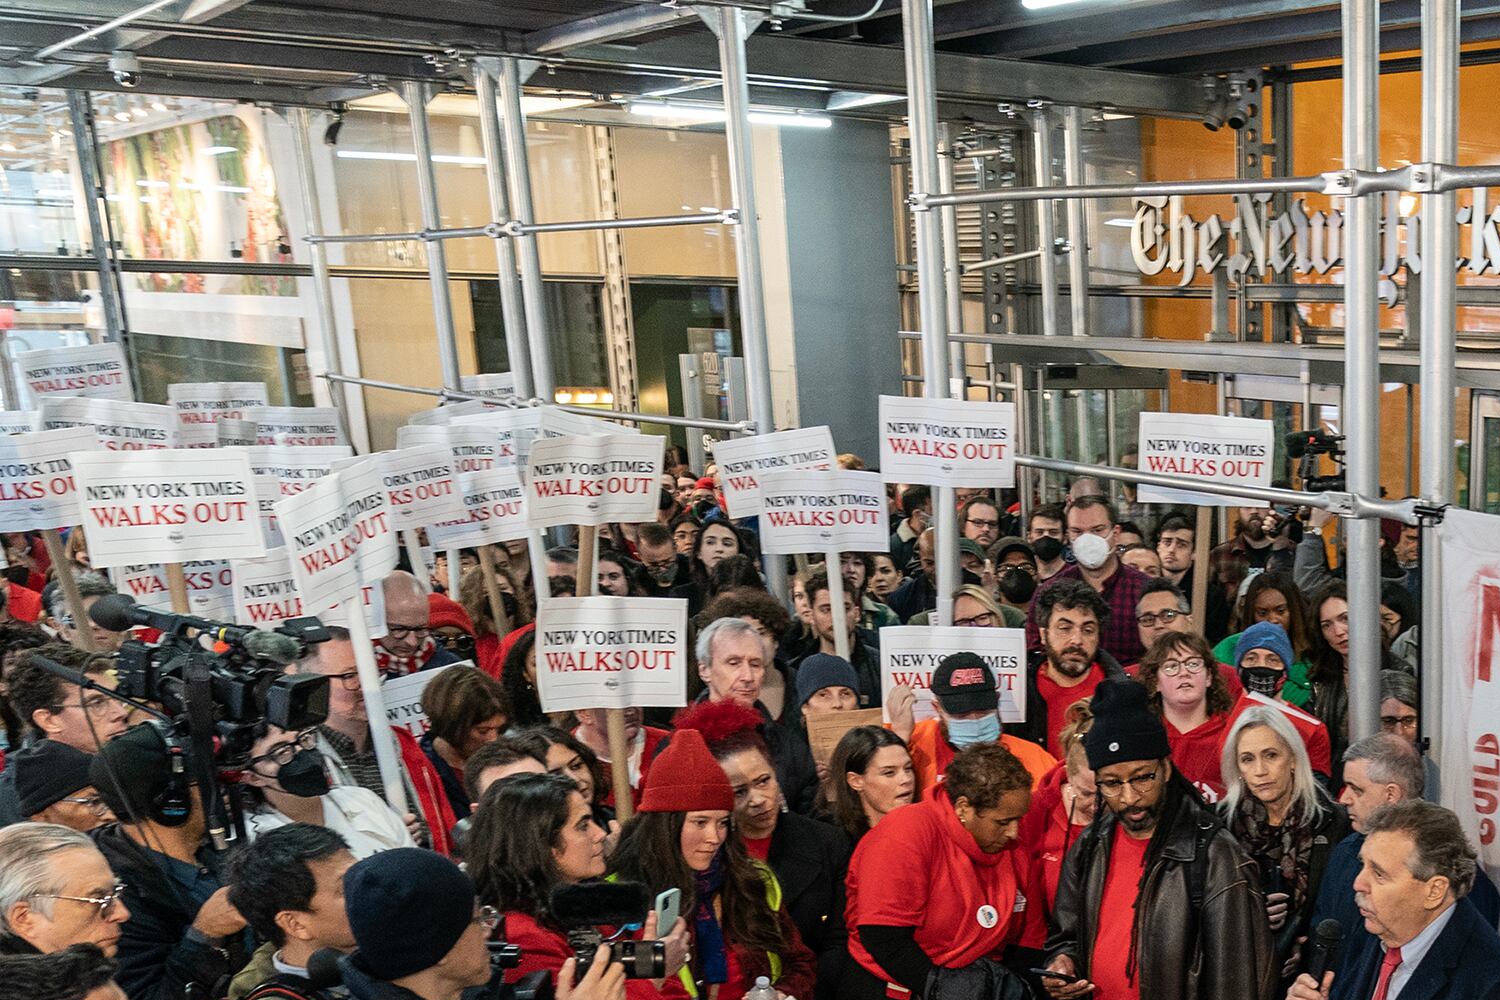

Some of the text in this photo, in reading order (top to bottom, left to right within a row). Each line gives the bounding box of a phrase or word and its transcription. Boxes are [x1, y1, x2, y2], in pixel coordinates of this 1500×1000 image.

[1130, 194, 1223, 287] The
[29, 372, 123, 393] WALKS OUT
[886, 422, 1007, 440] NEW YORK TIMES
[887, 438, 1008, 460] WALKS OUT
[1146, 440, 1266, 457] NEW YORK TIMES
[533, 460, 655, 477] NEW YORK TIMES
[723, 460, 754, 475] NEW
[755, 455, 789, 469] YORK
[790, 450, 828, 464] TIMES
[1147, 456, 1264, 478] WALKS OUT
[383, 465, 450, 488] ORK TIMES
[533, 476, 653, 498] WALKS OUT
[86, 484, 129, 501] NEW
[131, 482, 188, 499] YORK
[191, 481, 245, 497] TIMES
[416, 479, 453, 500] OUT
[463, 487, 522, 506] ORK TIME
[764, 494, 880, 508] NEW YORK TIMES
[90, 503, 188, 528] WALKS
[193, 501, 248, 523] OUT
[767, 509, 880, 528] WALKS OUT
[294, 524, 325, 551] NEW
[126, 570, 215, 597] WAKS
[243, 581, 284, 600] NEW
[543, 629, 677, 646] NEW YORK TIMES
[545, 649, 676, 673] WALKS OUT
[890, 654, 926, 667] NEW
[1472, 732, 1500, 846] GUILD
